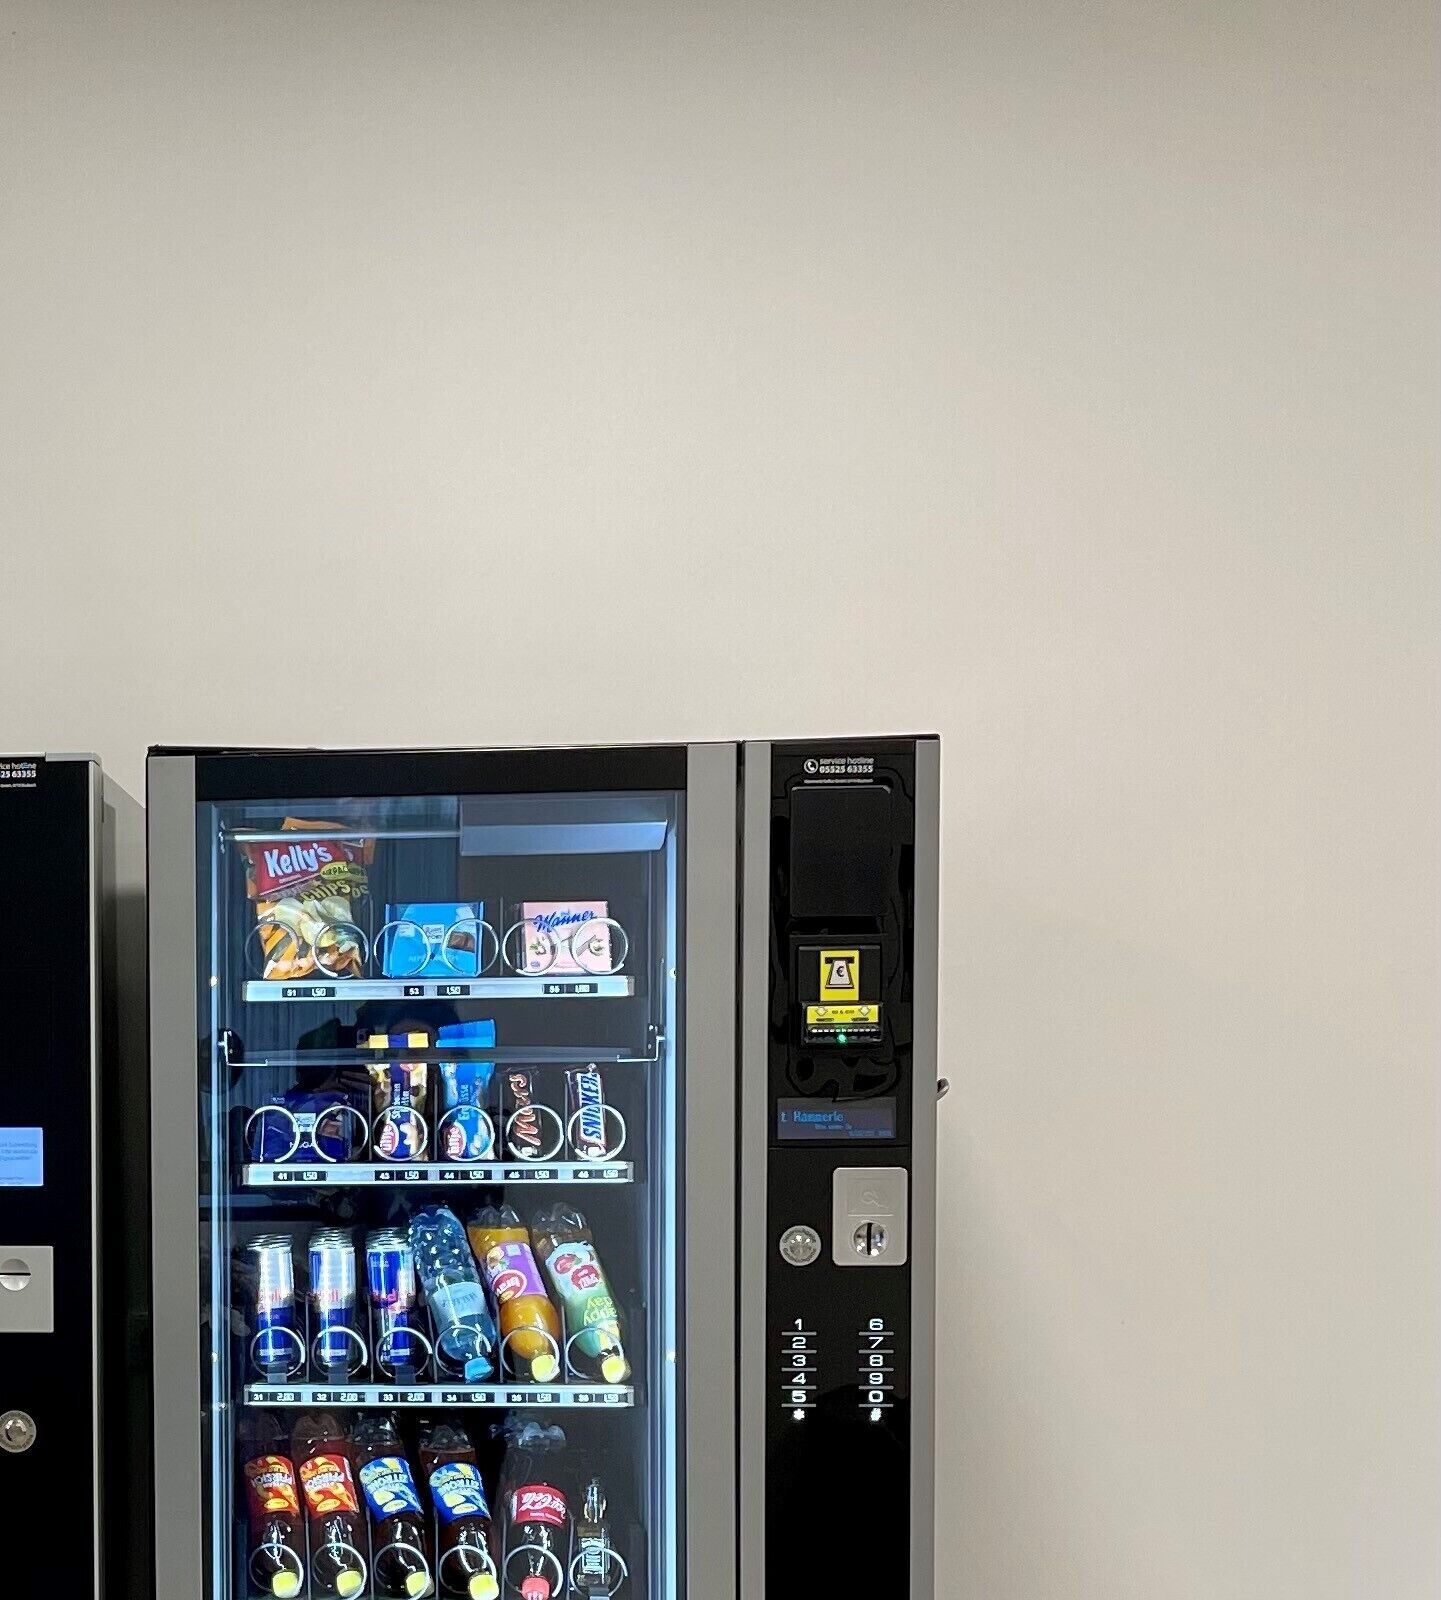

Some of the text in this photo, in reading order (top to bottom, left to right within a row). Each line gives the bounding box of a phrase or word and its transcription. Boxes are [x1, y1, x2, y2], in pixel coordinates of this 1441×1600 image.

[11, 761, 37, 770] hotline
[819, 765, 846, 774] 05525
[11, 770, 37, 778] 63355
[263, 842, 334, 878] Kelly's
[533, 909, 597, 934] Manner
[794, 1318, 803, 1331] 1
[869, 1318, 884, 1331] 6
[791, 1336, 807, 1349] 2
[868, 1336, 884, 1349] 7
[792, 1355, 807, 1367] 3
[869, 1355, 884, 1367] 8
[791, 1372, 807, 1385] 4
[869, 1372, 884, 1385] 9
[791, 1390, 807, 1403] 5
[868, 1390, 884, 1403] 0
